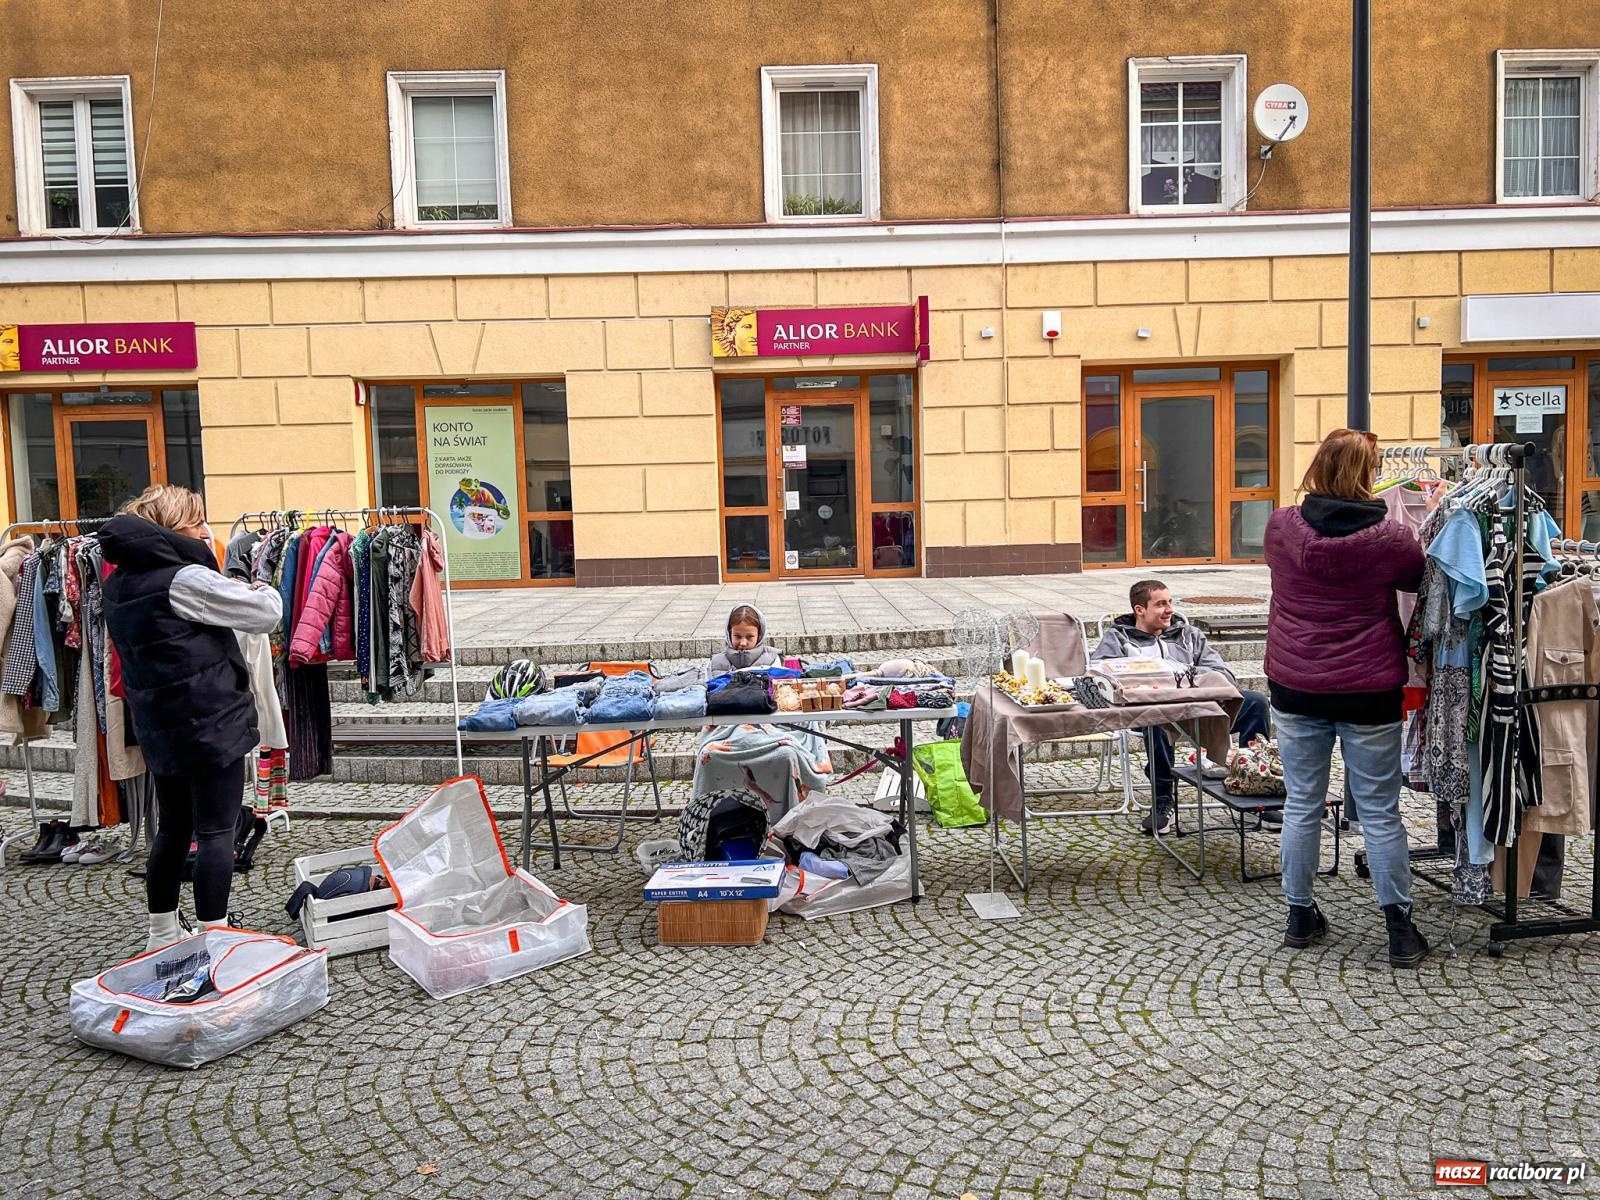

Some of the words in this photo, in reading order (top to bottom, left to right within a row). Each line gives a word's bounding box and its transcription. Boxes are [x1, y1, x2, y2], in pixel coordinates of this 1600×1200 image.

[773, 323, 839, 340] ALIOR
[844, 321, 900, 339] BANK
[41, 338, 111, 355] ALIOR
[115, 337, 173, 354] BANK
[773, 342, 811, 350] PARTNER
[41, 357, 81, 365] PARTNER
[1514, 391, 1561, 407] Stella
[432, 422, 473, 432] KONTO
[433, 437, 451, 447] NA
[453, 434, 488, 447] ŚWIAT
[697, 890, 709, 898] A4
